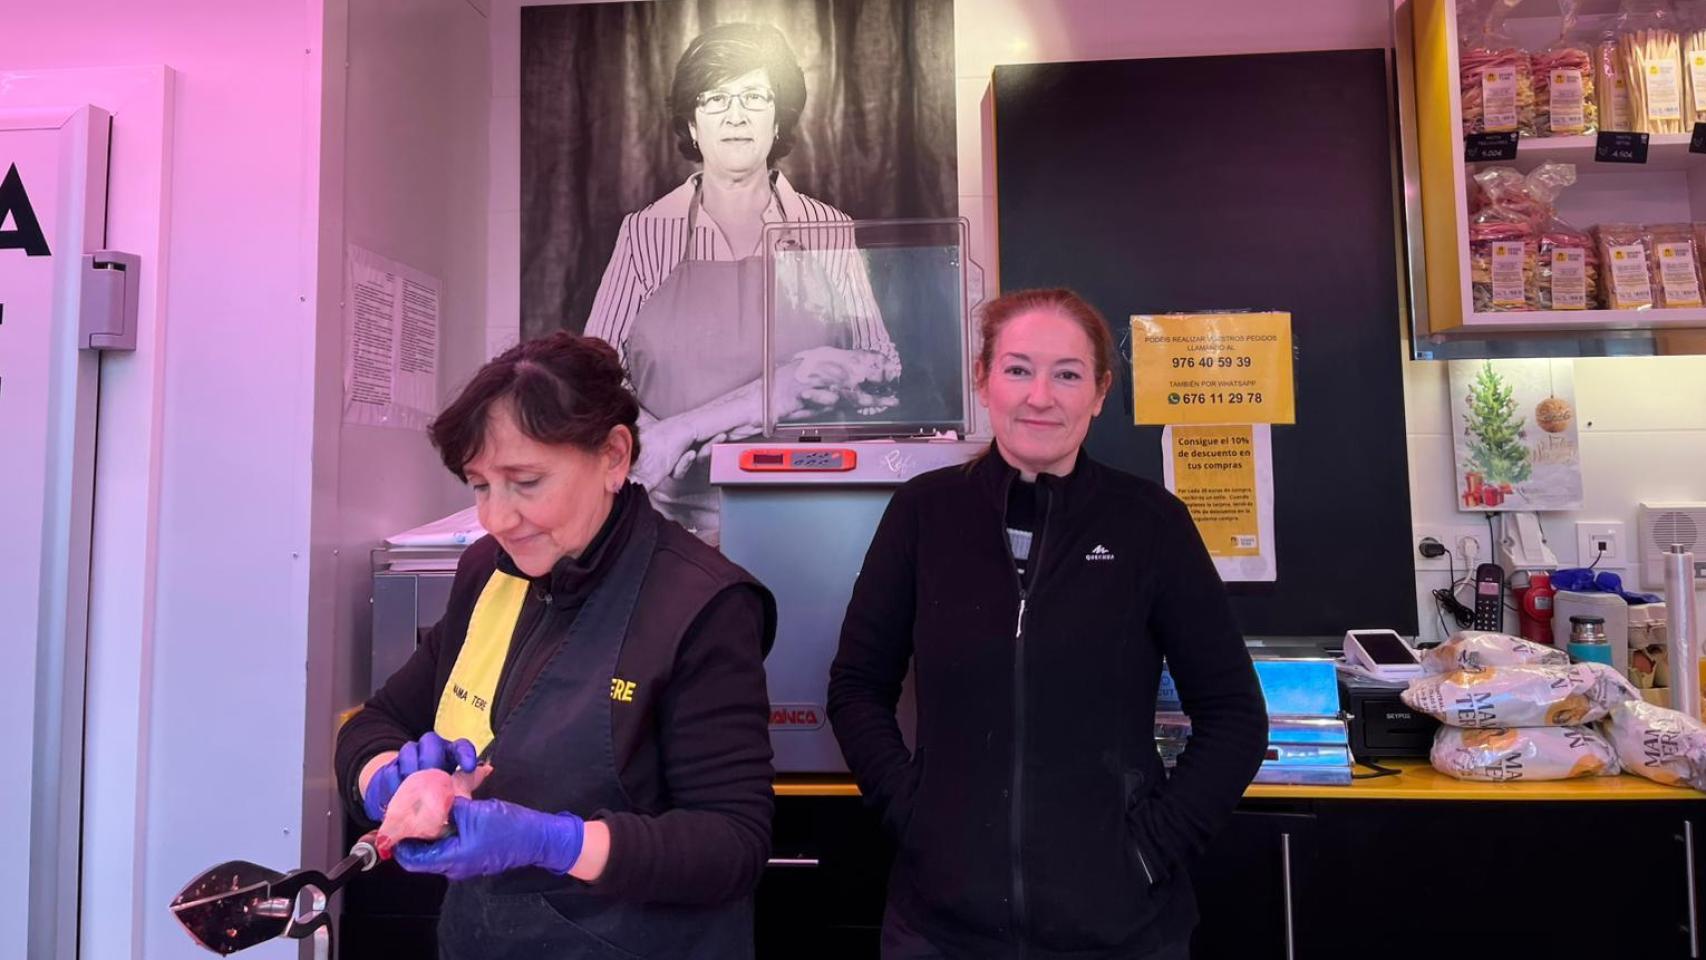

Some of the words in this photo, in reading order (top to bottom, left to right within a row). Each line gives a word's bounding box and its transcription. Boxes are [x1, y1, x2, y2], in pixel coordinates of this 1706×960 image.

[1172, 357, 1195, 368] 976
[1198, 357, 1213, 367] 40
[1218, 357, 1233, 367] 59
[1236, 356, 1251, 367] 39
[1183, 393, 1206, 404] 676
[1210, 393, 1224, 403] 11
[1228, 393, 1243, 403] 29
[1248, 392, 1262, 403] 78
[1178, 438, 1219, 447] Consigue
[1220, 437, 1229, 445] el
[1231, 437, 1249, 445] 10%
[1204, 462, 1242, 470] compras
[471, 695, 488, 712] TERE
